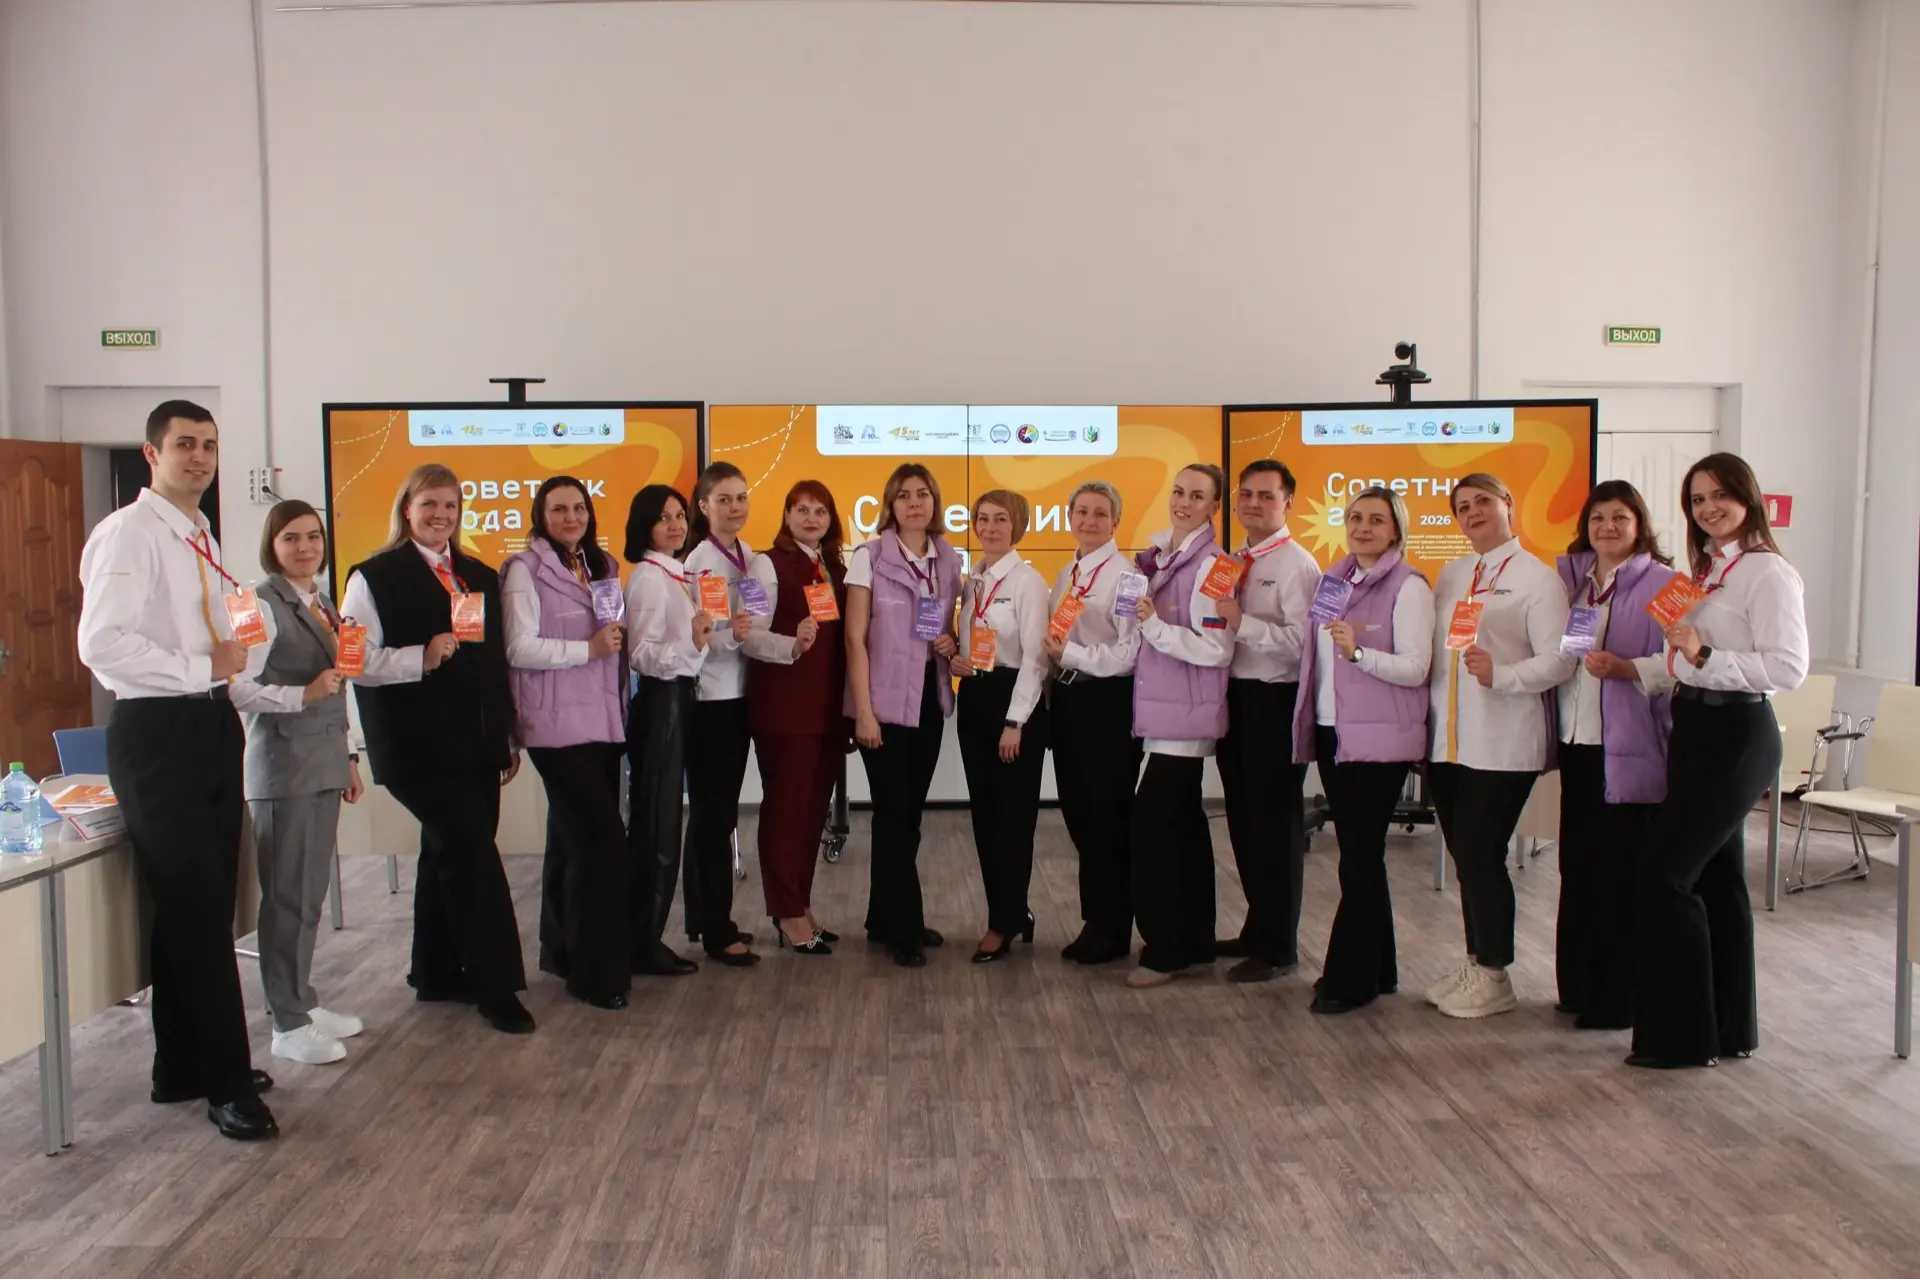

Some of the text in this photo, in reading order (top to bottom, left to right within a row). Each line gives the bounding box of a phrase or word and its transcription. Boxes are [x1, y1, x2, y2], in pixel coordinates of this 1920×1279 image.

[106, 332, 151, 346] ВЫХОД
[1613, 329, 1656, 342] ВЫХОД
[460, 479, 607, 499] оветк
[1327, 472, 1460, 497] Соетн
[461, 508, 522, 532] ода
[1420, 515, 1451, 525] 2026
